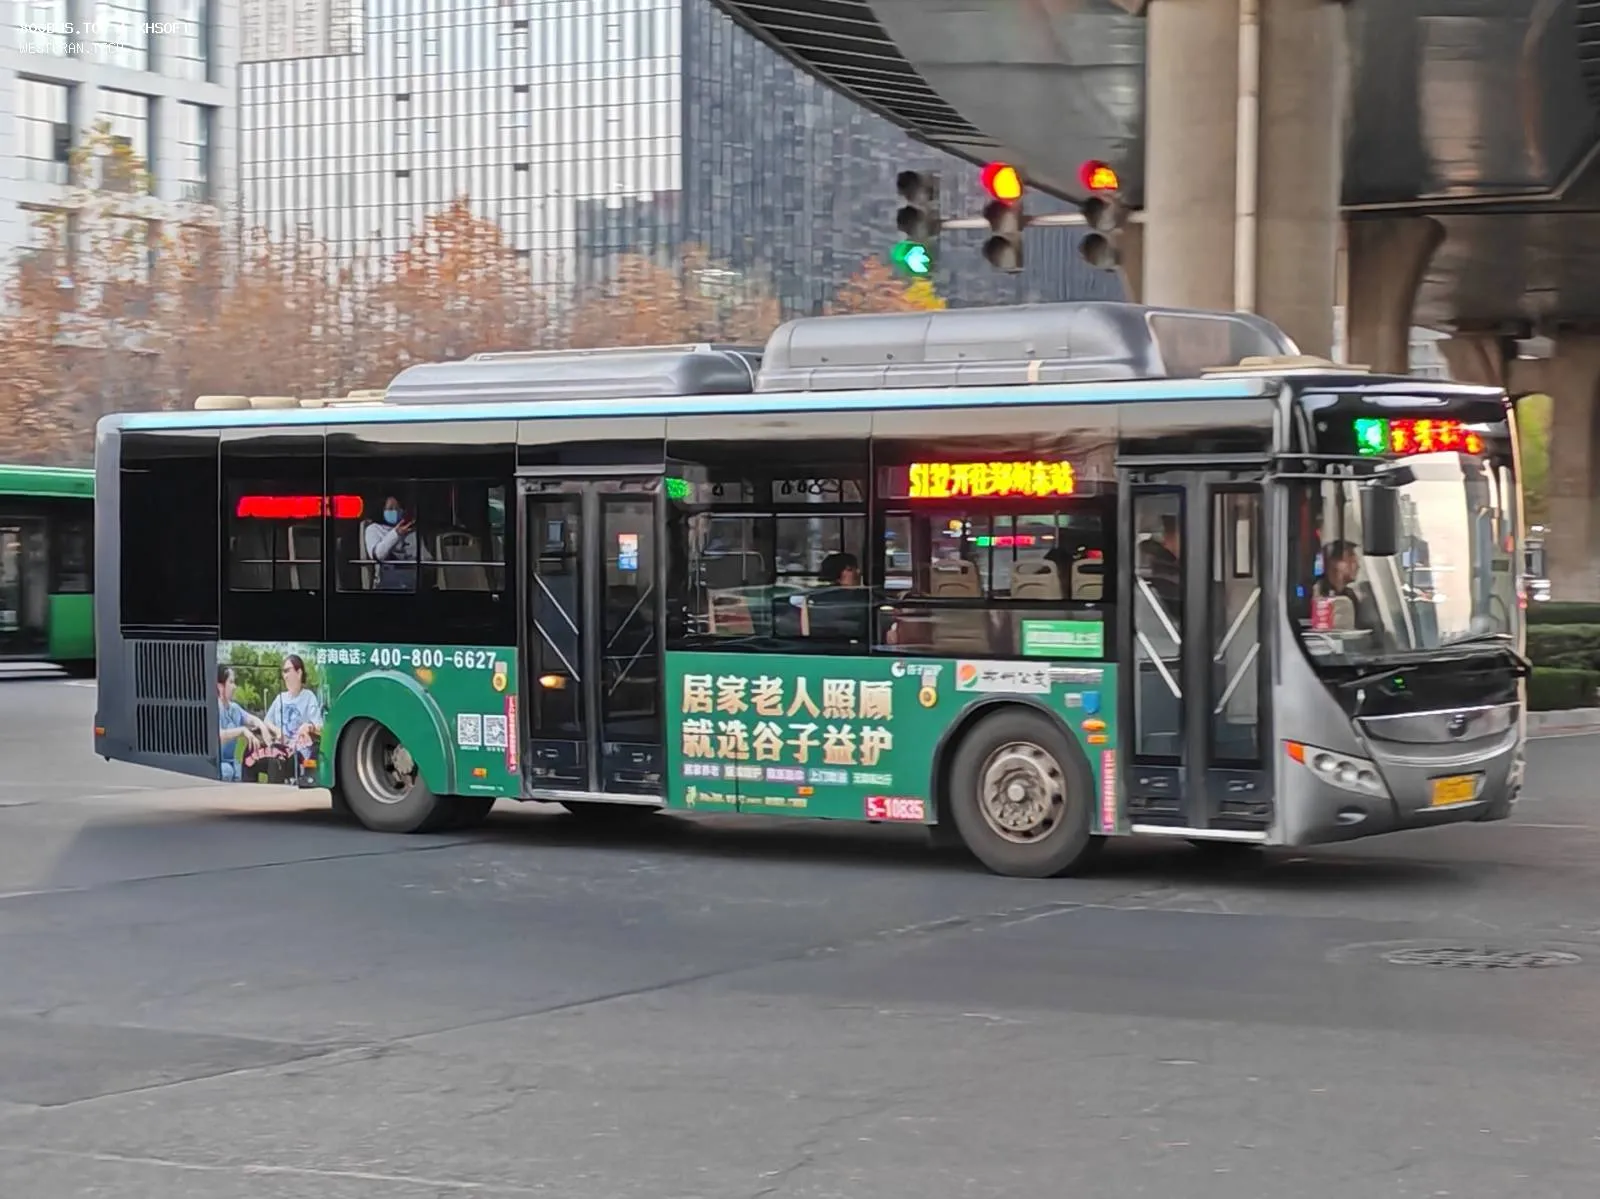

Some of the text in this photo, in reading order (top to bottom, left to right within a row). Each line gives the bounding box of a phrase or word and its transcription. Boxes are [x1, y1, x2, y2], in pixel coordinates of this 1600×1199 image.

[682, 673, 894, 721] 居家老人照顾
[682, 718, 893, 767] 就选谷子益护
